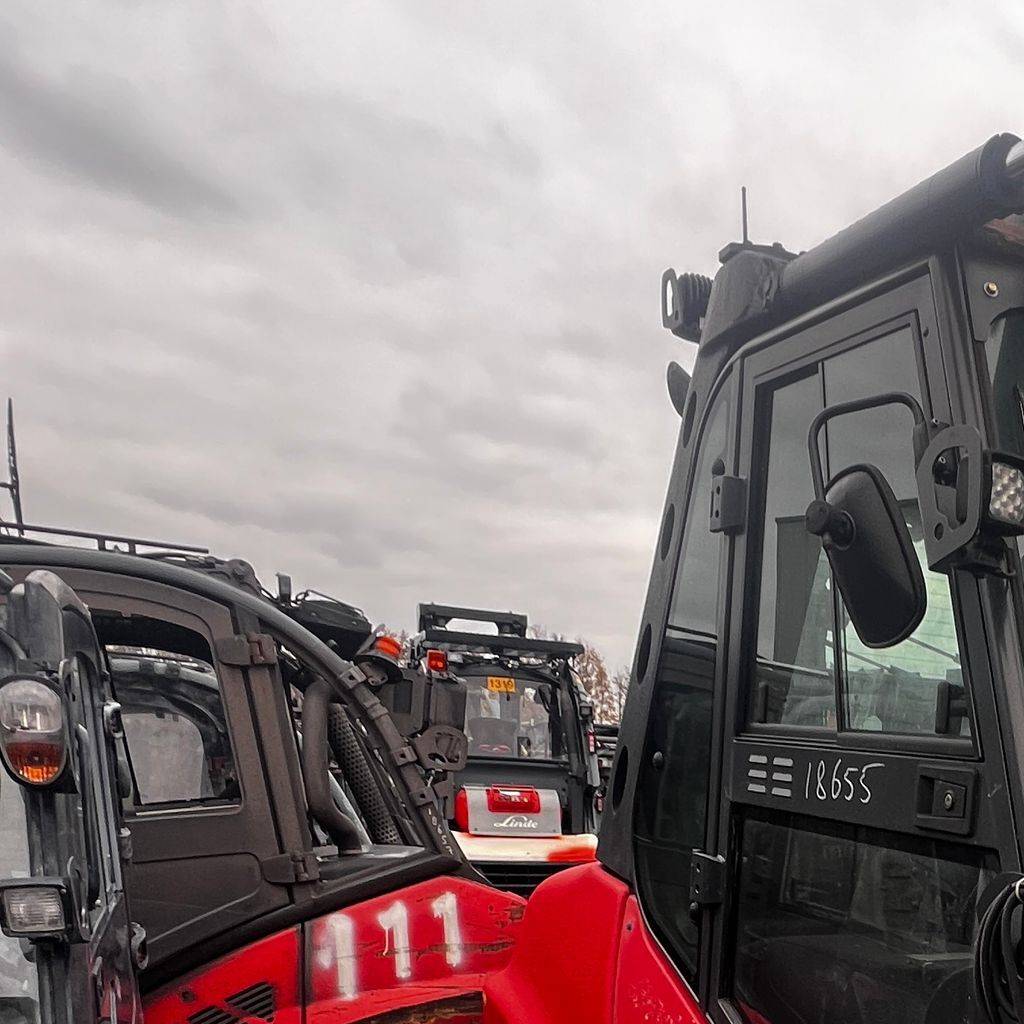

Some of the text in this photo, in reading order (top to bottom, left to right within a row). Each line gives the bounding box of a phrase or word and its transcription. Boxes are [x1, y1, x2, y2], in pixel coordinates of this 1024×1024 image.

[805, 758, 885, 803] 18655
[493, 815, 538, 828] Linde
[317, 891, 462, 999] 111
